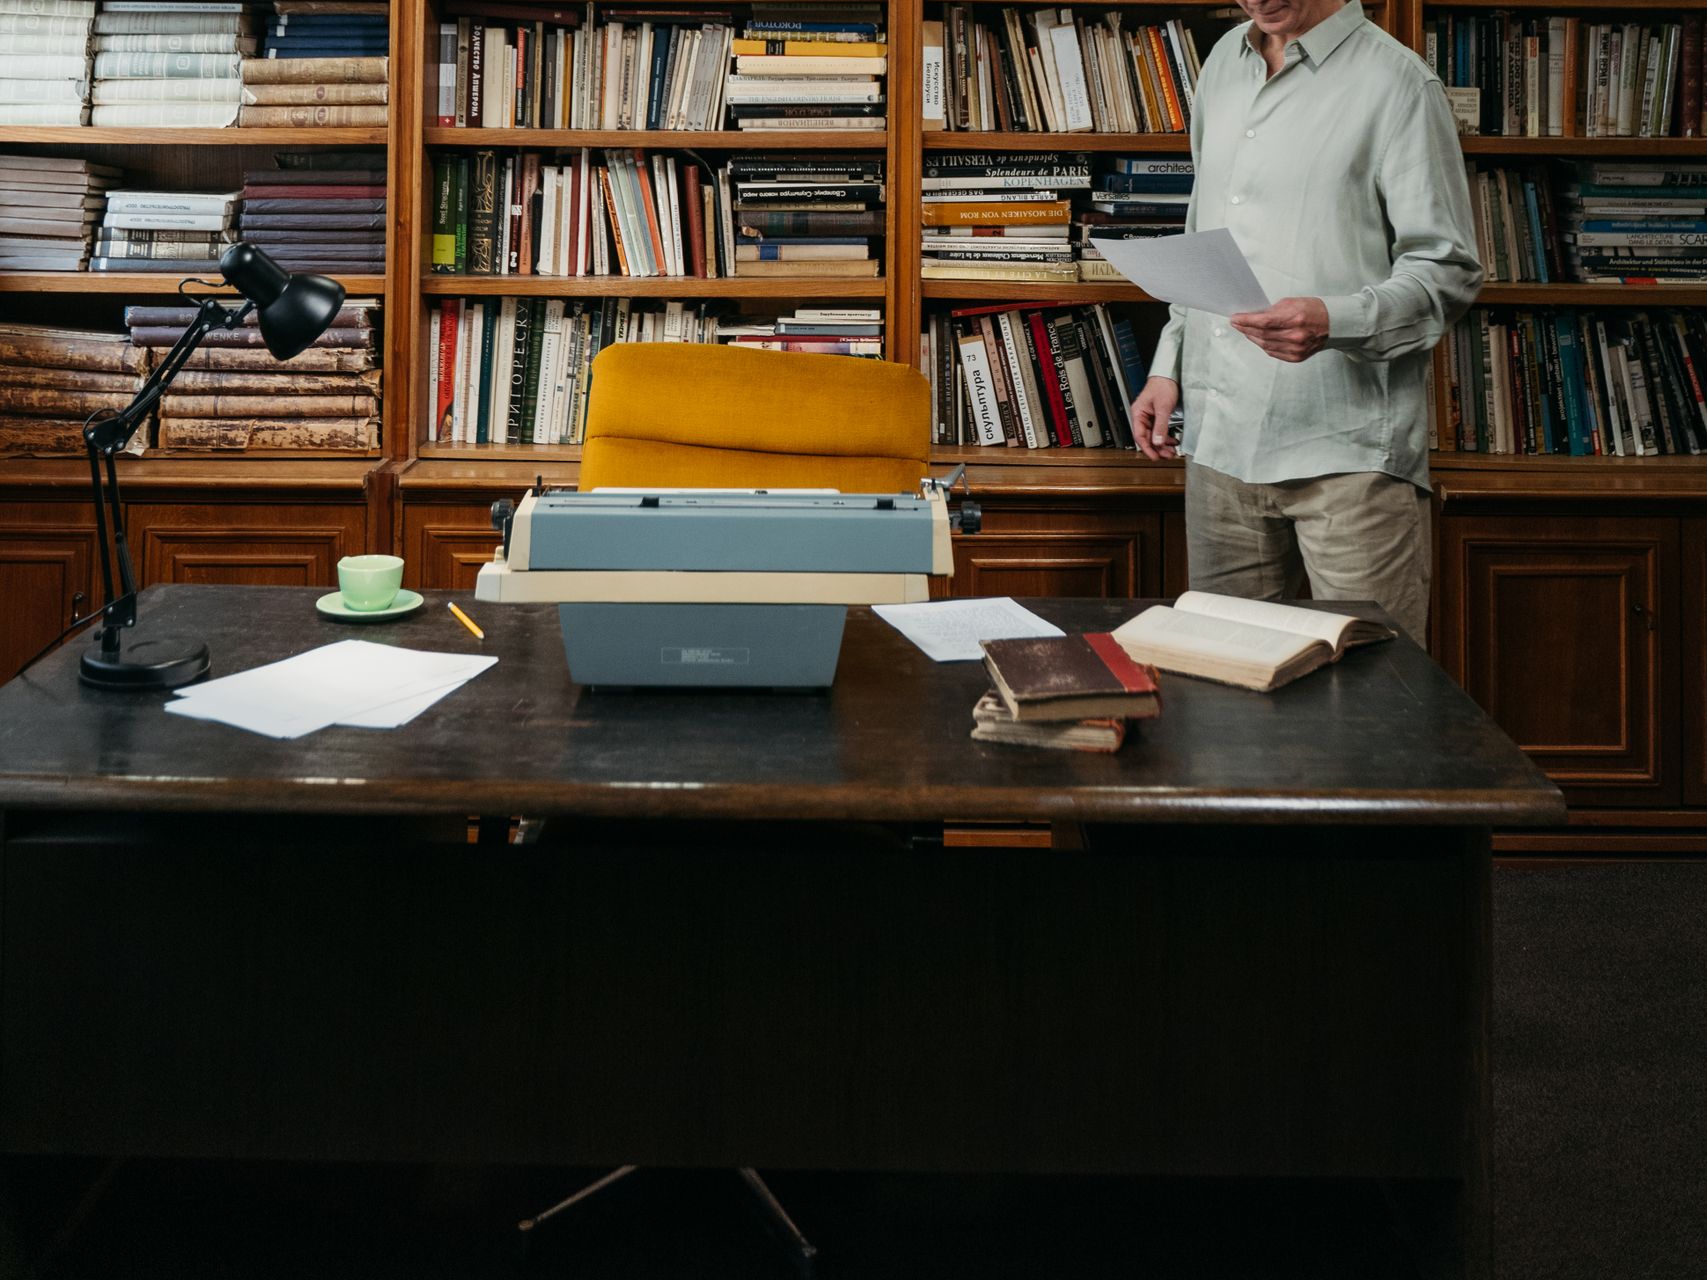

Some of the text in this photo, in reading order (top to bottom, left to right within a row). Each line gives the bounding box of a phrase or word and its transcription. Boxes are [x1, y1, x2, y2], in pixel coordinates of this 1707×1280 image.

[925, 62, 933, 104] Беларуси
[778, 119, 835, 127] ВЕНЕЦИАНОВ
[926, 154, 1059, 167] Splendeurs de VERSAILLES
[985, 165, 1089, 177] Splendeurs de PARIS
[1003, 177, 1085, 187] KOPENHAGEN
[1001, 210, 1047, 218] MOSAIKEN
[1048, 209, 1063, 217] DIE
[966, 353, 977, 362] 73
[506, 304, 528, 441] ГРИГОРЕСКУ
[1046, 322, 1074, 410] Les Rois de France
[1552, 359, 1562, 382] gebaut
[1000, 316, 1035, 447] HORNIG LEIPZIGER PLAKATKUNST
[971, 369, 995, 440] скульптура
